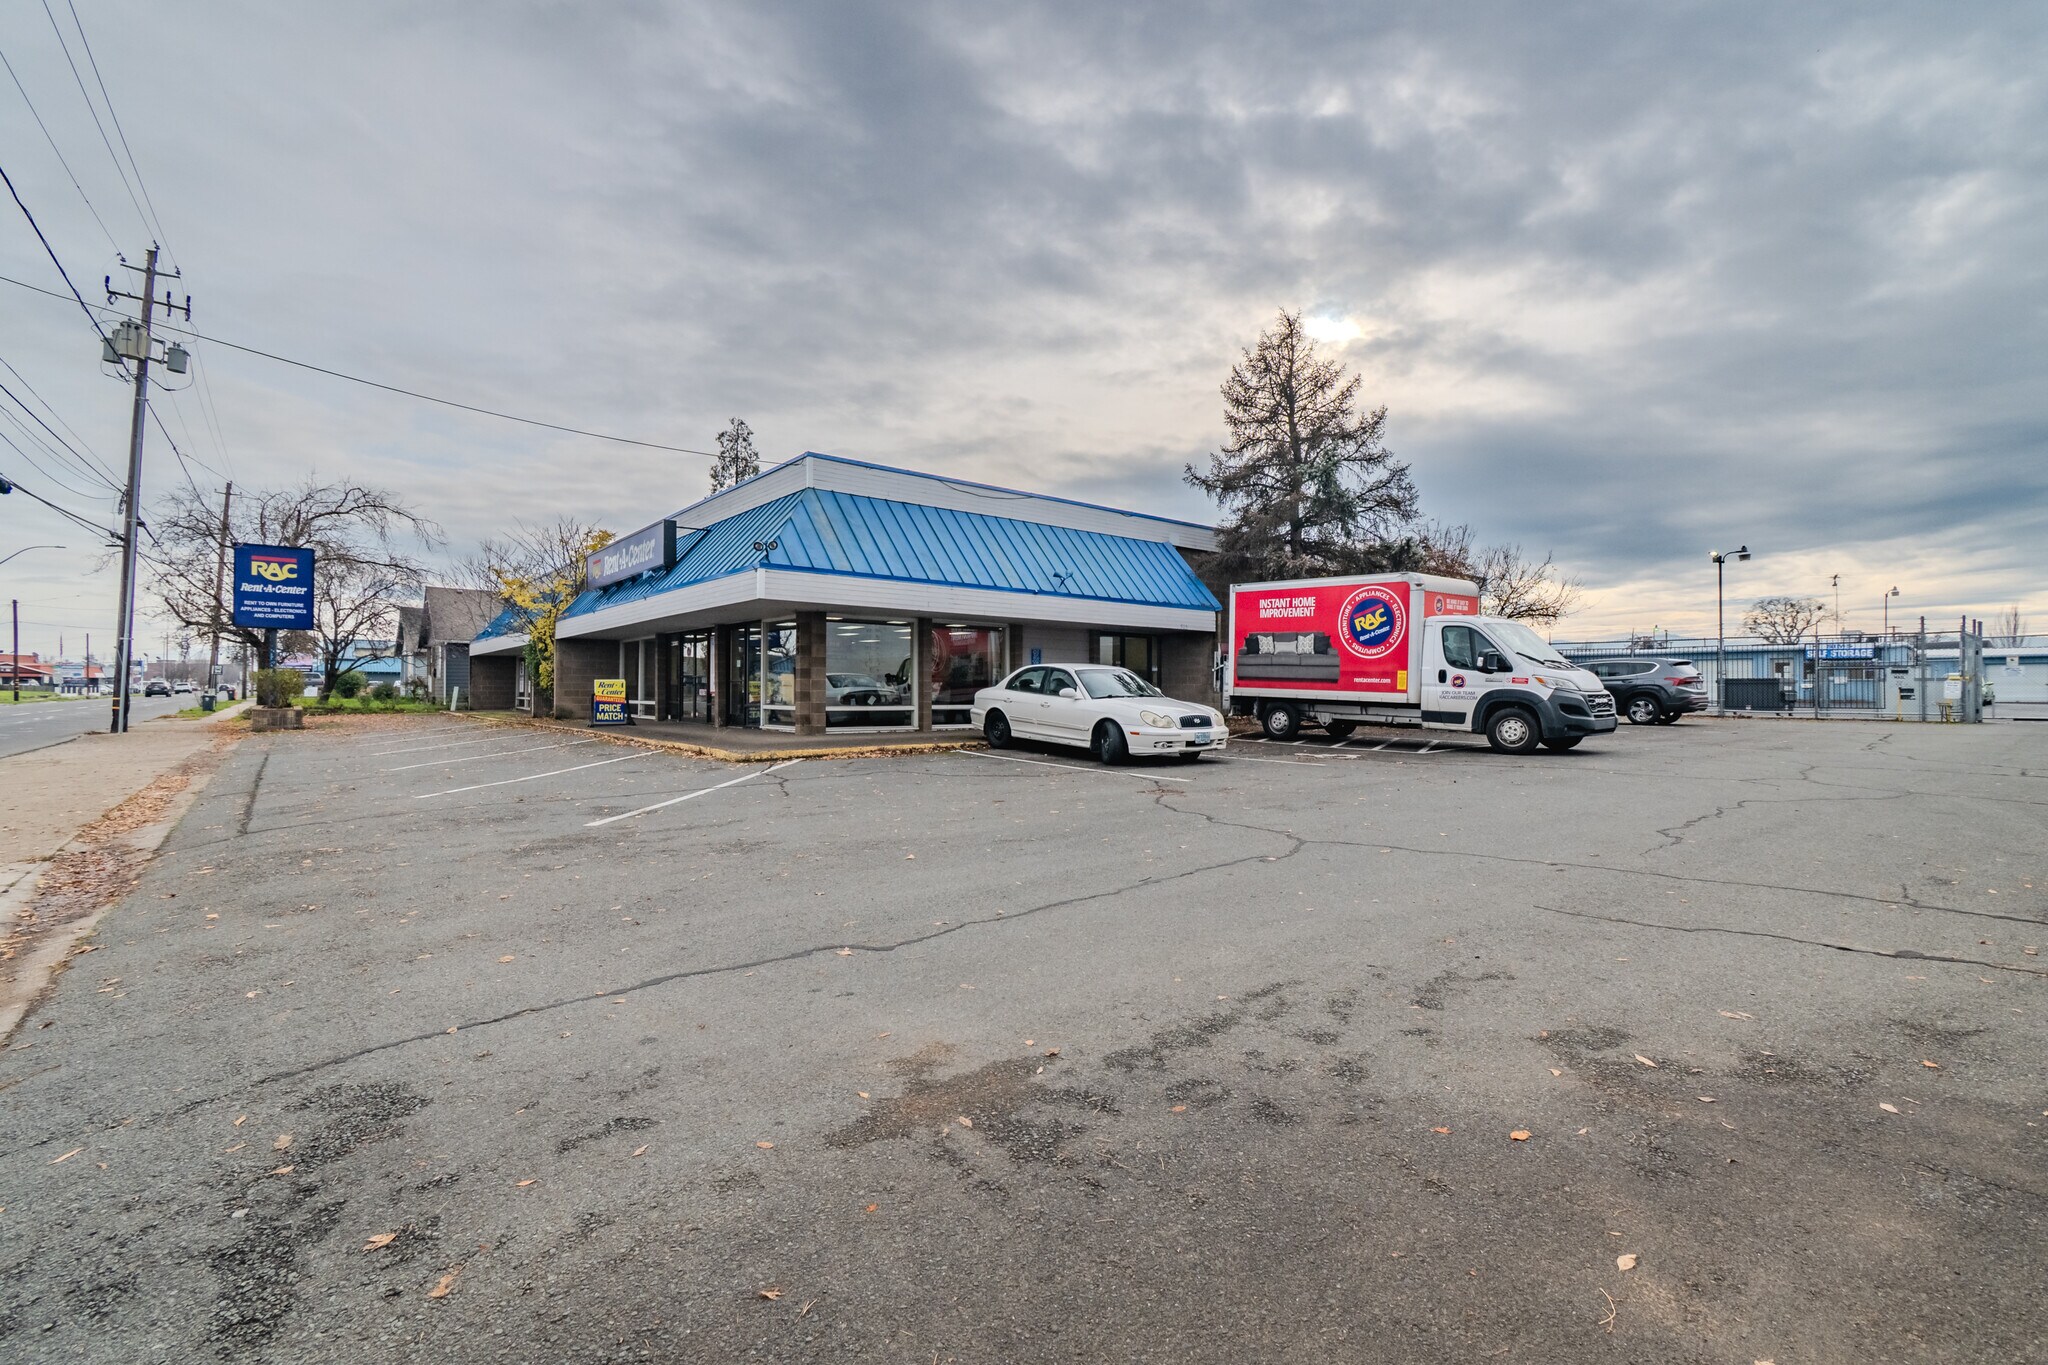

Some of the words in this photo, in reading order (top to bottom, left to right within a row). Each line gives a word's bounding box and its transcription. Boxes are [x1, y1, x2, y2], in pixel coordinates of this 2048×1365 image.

[251, 561, 297, 581] RAC
[1355, 591, 1390, 601] APPLIANCES
[1260, 598, 1291, 608] INSTANT
[1292, 596, 1316, 607] HOME
[1260, 607, 1315, 618] IMPROVEMENT
[1342, 604, 1352, 639] FURNITURE
[1354, 608, 1387, 631] RAC
[1390, 603, 1402, 643] ELECTRONICS
[1352, 643, 1385, 654] COMPUTERS
[1830, 649, 1873, 657] STORAGE
[599, 704, 621, 712] PRICE
